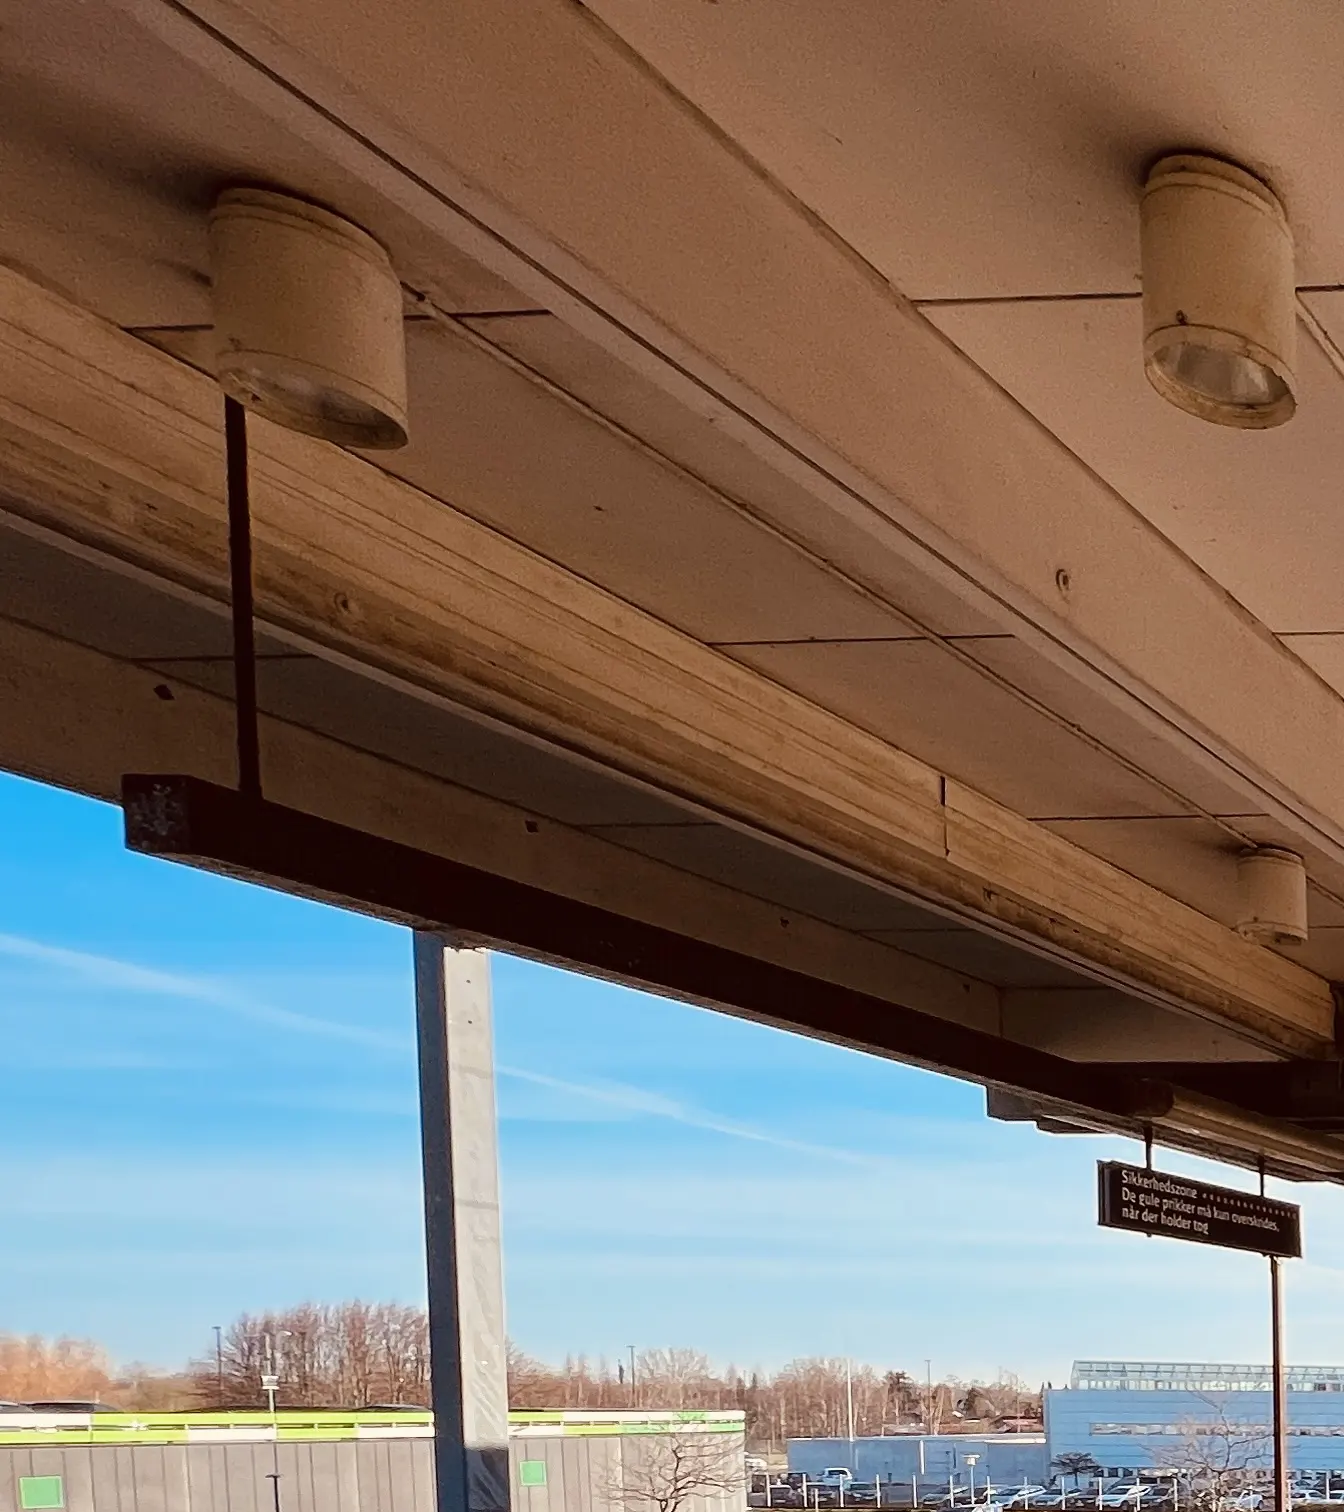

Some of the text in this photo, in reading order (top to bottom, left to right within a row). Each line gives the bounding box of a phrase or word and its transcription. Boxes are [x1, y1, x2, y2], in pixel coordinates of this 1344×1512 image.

[1122, 1170, 1197, 1198] Sikkerhedszone
[1122, 1187, 1136, 1203] De
[1138, 1192, 1160, 1207] gule
[1162, 1197, 1195, 1214] prikker
[1122, 1204, 1209, 1236] når der holder tog
